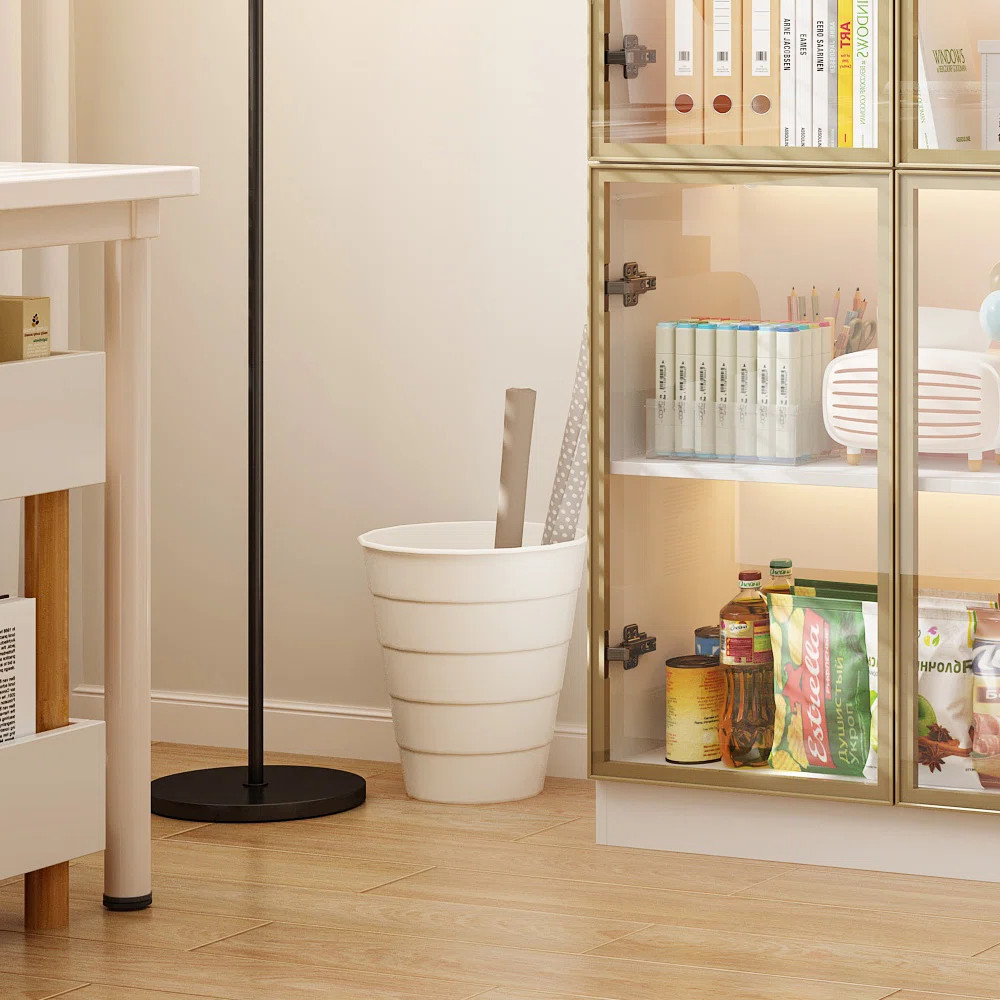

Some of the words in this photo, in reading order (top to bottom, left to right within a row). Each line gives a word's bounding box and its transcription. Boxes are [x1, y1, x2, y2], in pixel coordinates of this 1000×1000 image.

[783, 18, 791, 36] ARNE
[816, 20, 824, 38] EERO
[783, 37, 791, 71] JACOBSEN
[799, 33, 807, 56] EAMES
[816, 39, 824, 72] SAARINEN
[932, 48, 966, 66] WINDOWS
[807, 623, 827, 764] Estrella
